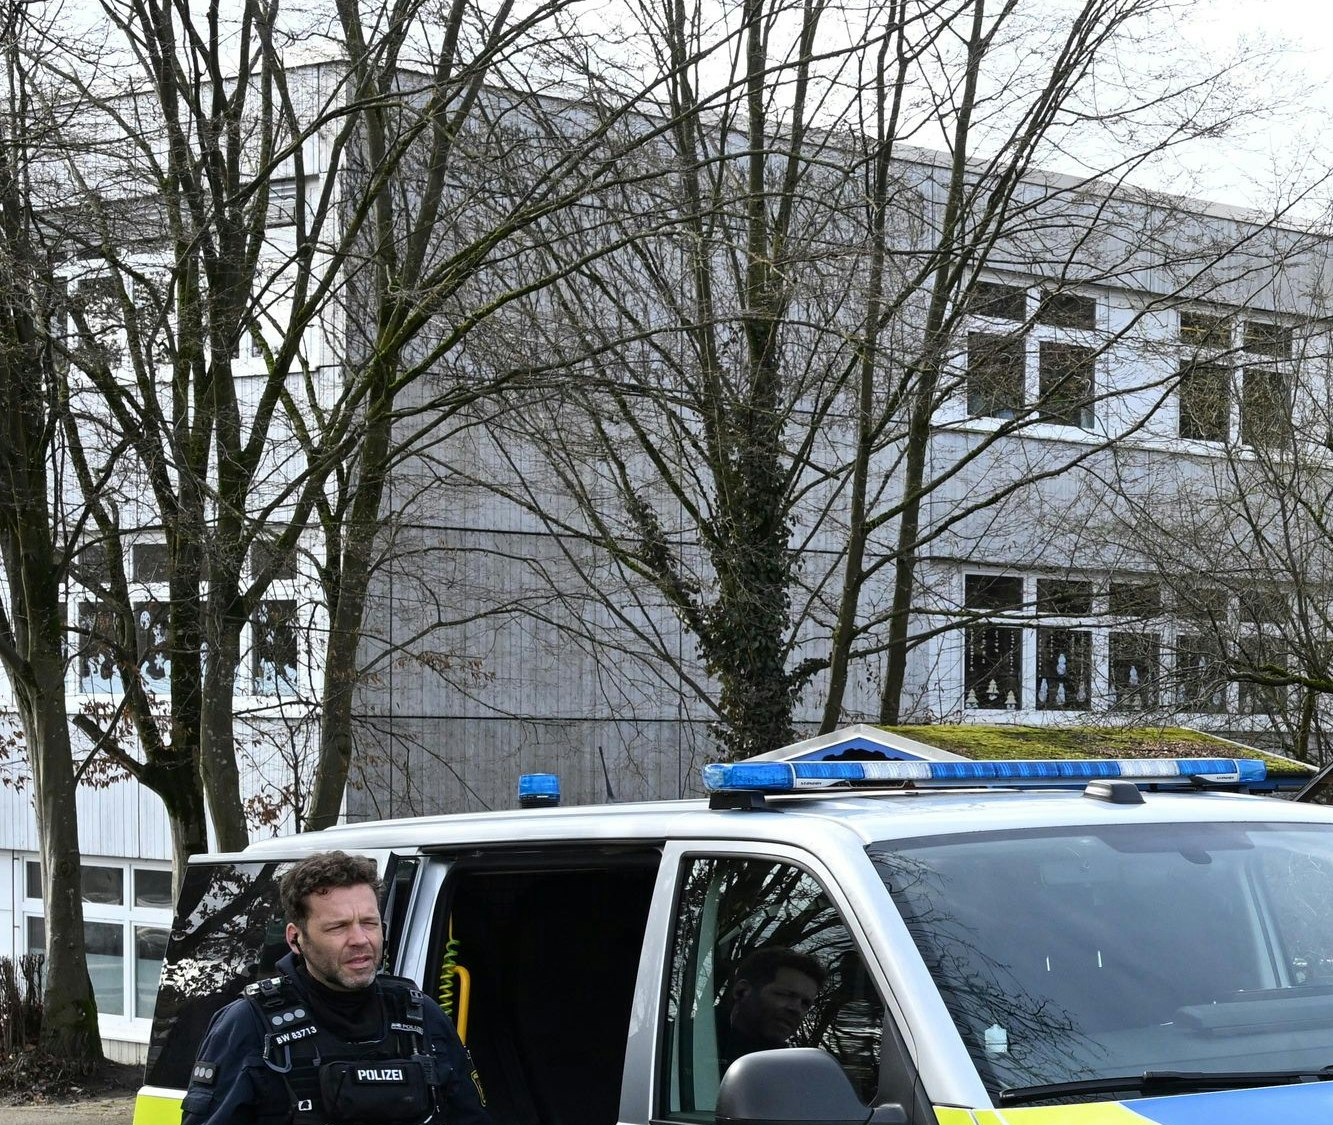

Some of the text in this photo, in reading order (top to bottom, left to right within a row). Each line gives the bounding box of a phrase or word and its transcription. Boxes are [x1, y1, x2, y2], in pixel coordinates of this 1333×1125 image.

[276, 1025, 317, 1045] BW 83713
[357, 1069, 404, 1081] POLIZEI
